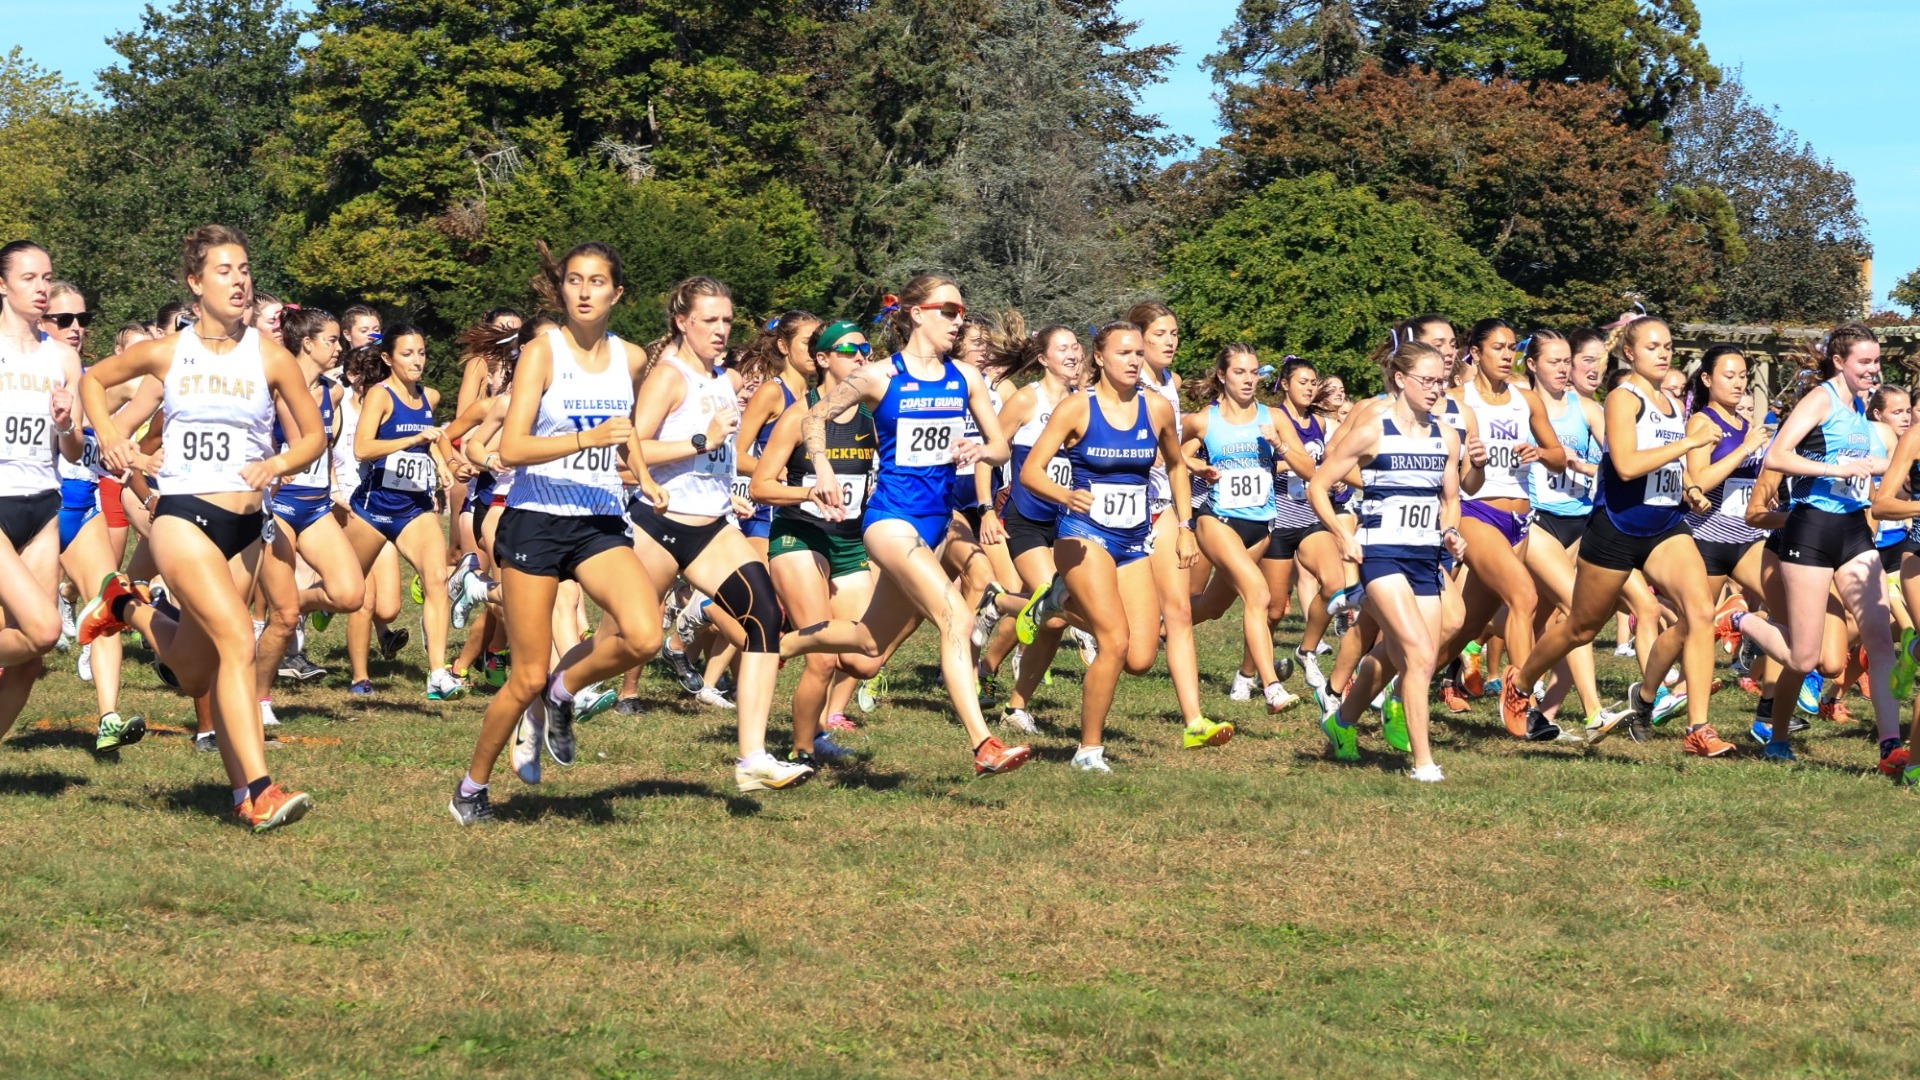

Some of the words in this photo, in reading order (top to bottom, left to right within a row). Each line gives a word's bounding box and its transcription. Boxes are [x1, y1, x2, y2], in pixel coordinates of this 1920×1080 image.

[20, 373, 53, 393] OLA
[179, 374, 205, 396] ST.
[208, 375, 255, 400] OLAF
[563, 400, 628, 410] WELLESLEY
[900, 397, 934, 409] COAST
[934, 397, 964, 408] GUARD
[5, 416, 46, 445] 952
[910, 426, 941, 452] 288
[183, 431, 230, 461] 953
[1086, 446, 1155, 458] MIDDLEBURY
[1222, 441, 1263, 456] JOHNS
[1489, 446, 1520, 468] 808
[395, 457, 422, 480] 661
[1390, 455, 1445, 470] BRANDEIS
[1231, 475, 1261, 496] 581
[1103, 493, 1136, 515] 671
[1399, 504, 1431, 528] 160
